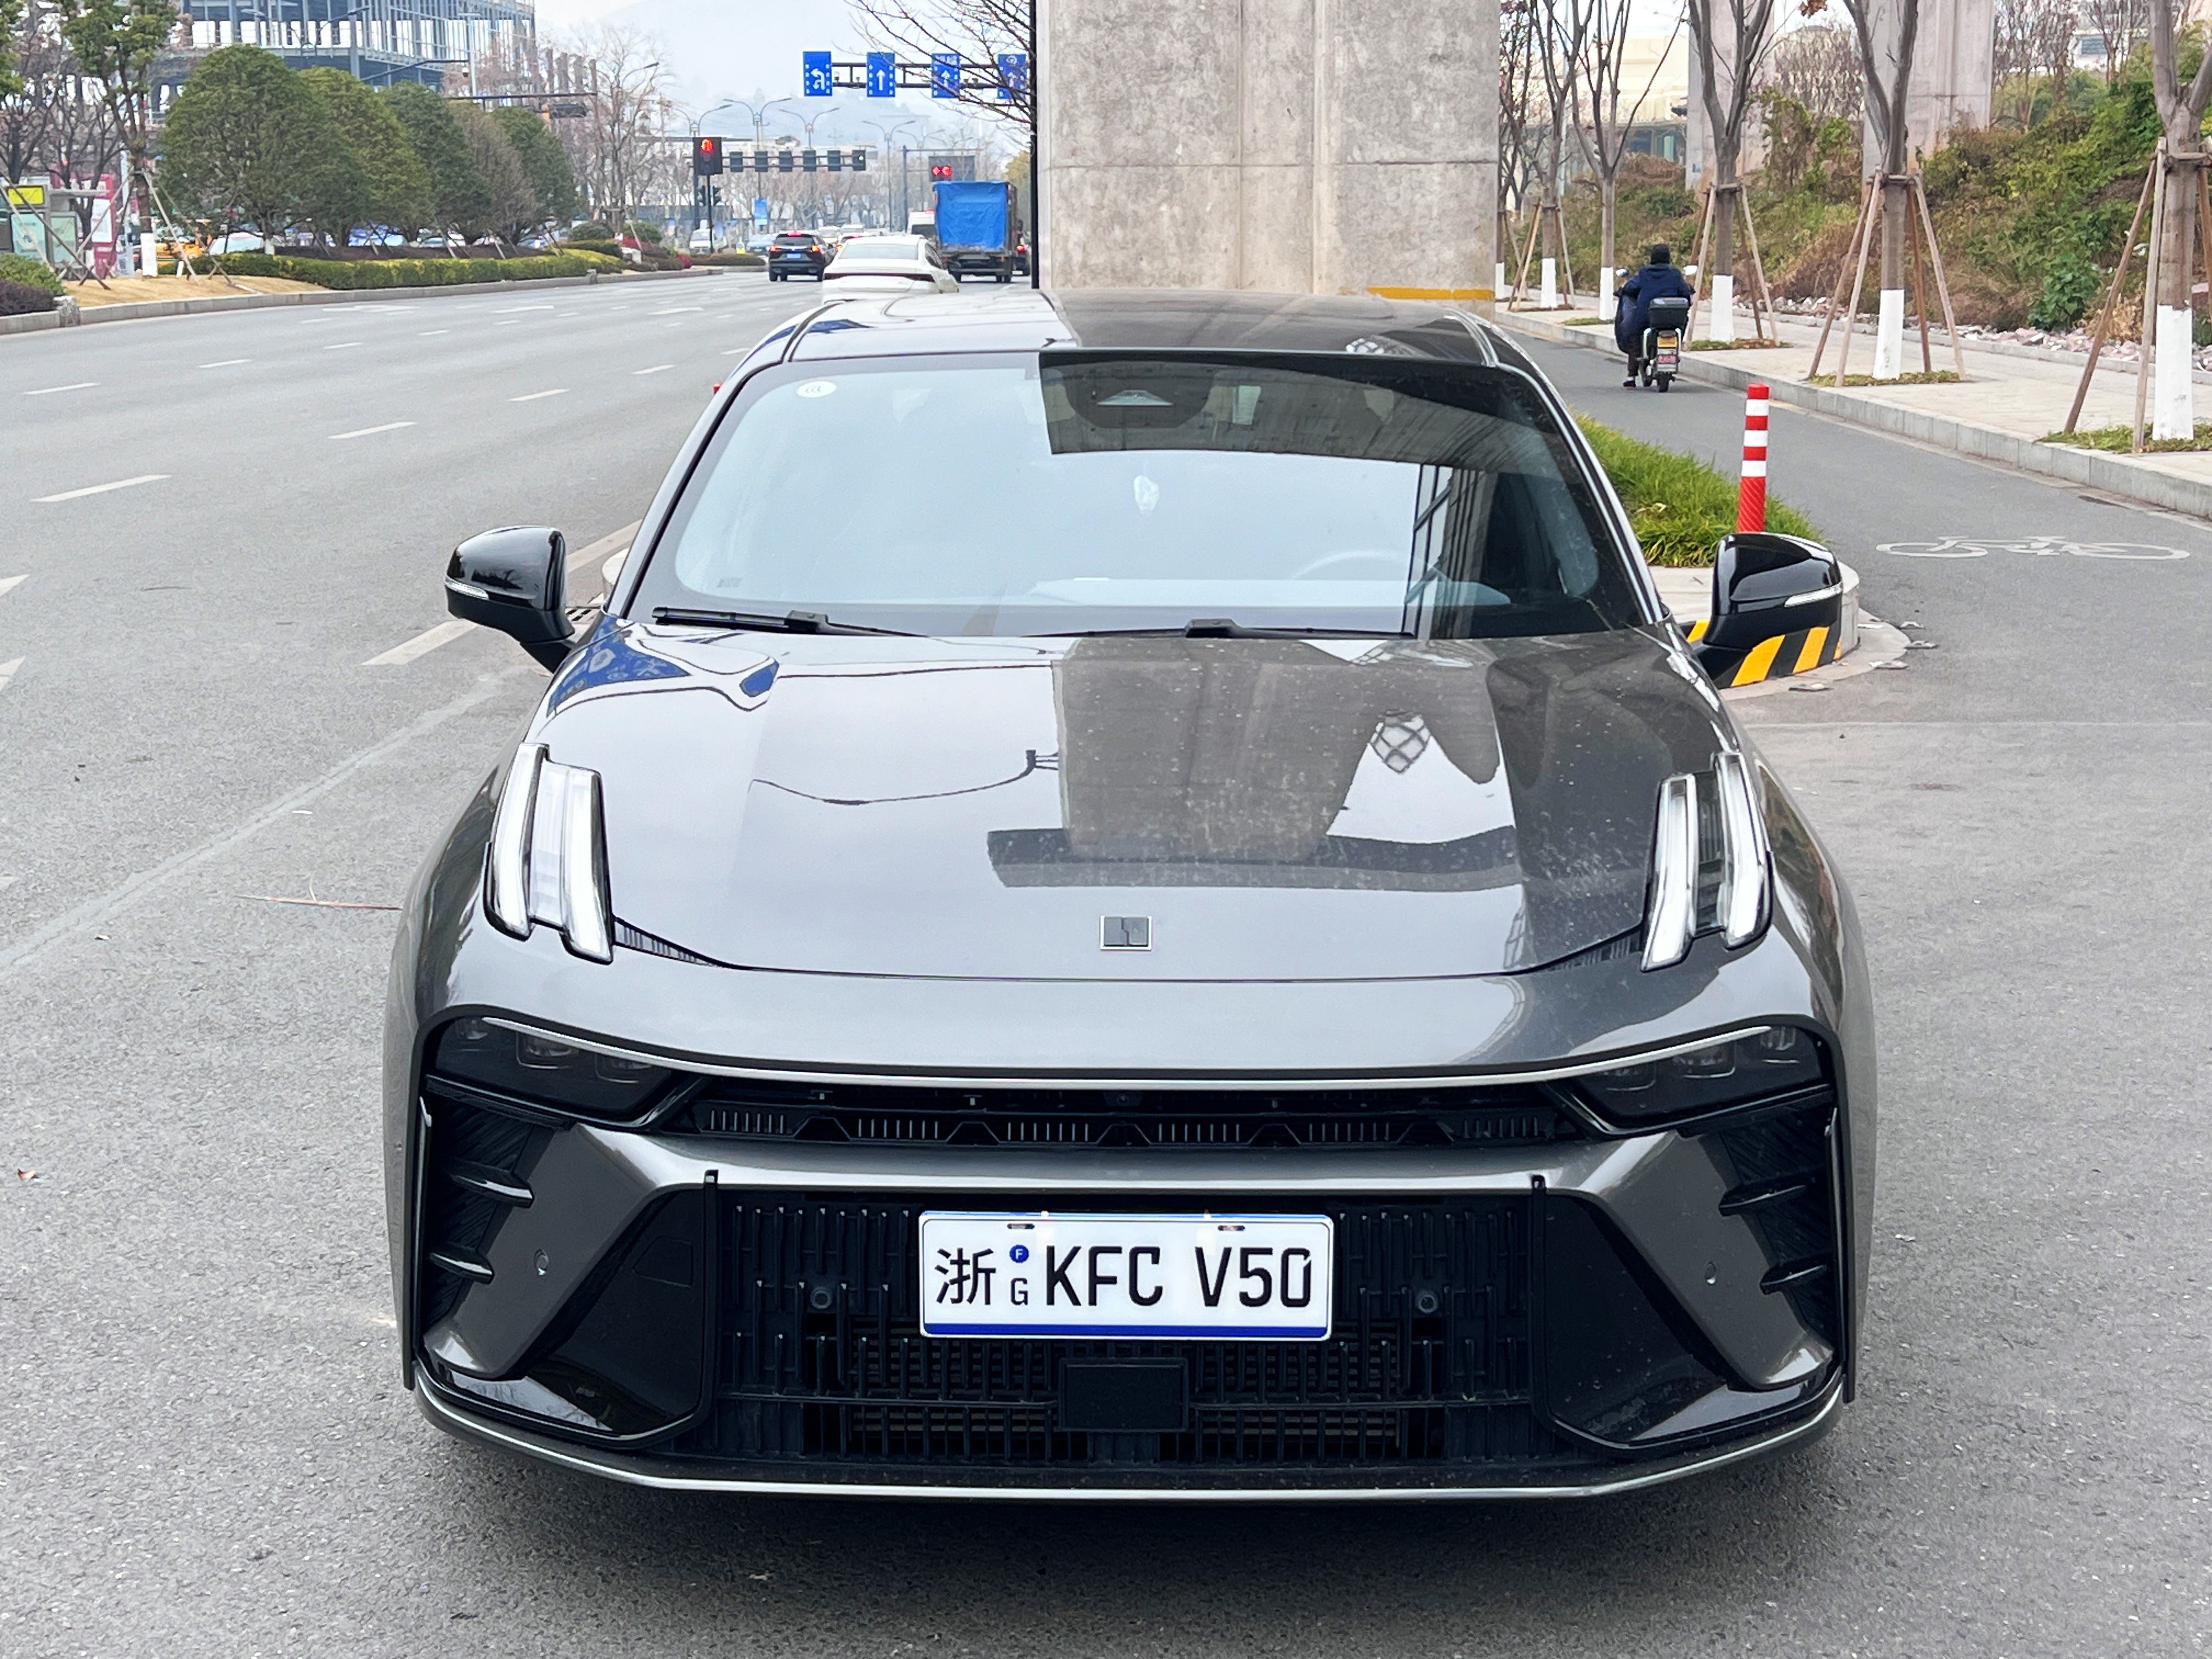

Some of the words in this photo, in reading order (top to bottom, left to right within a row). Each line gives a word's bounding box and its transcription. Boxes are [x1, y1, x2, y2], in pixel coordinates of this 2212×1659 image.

[1015, 1248, 1023, 1260] F
[934, 1248, 996, 1305] 浙
[1011, 1278, 1028, 1306] G
[1046, 1245, 1163, 1306] KFC
[1195, 1246, 1312, 1308] V50
